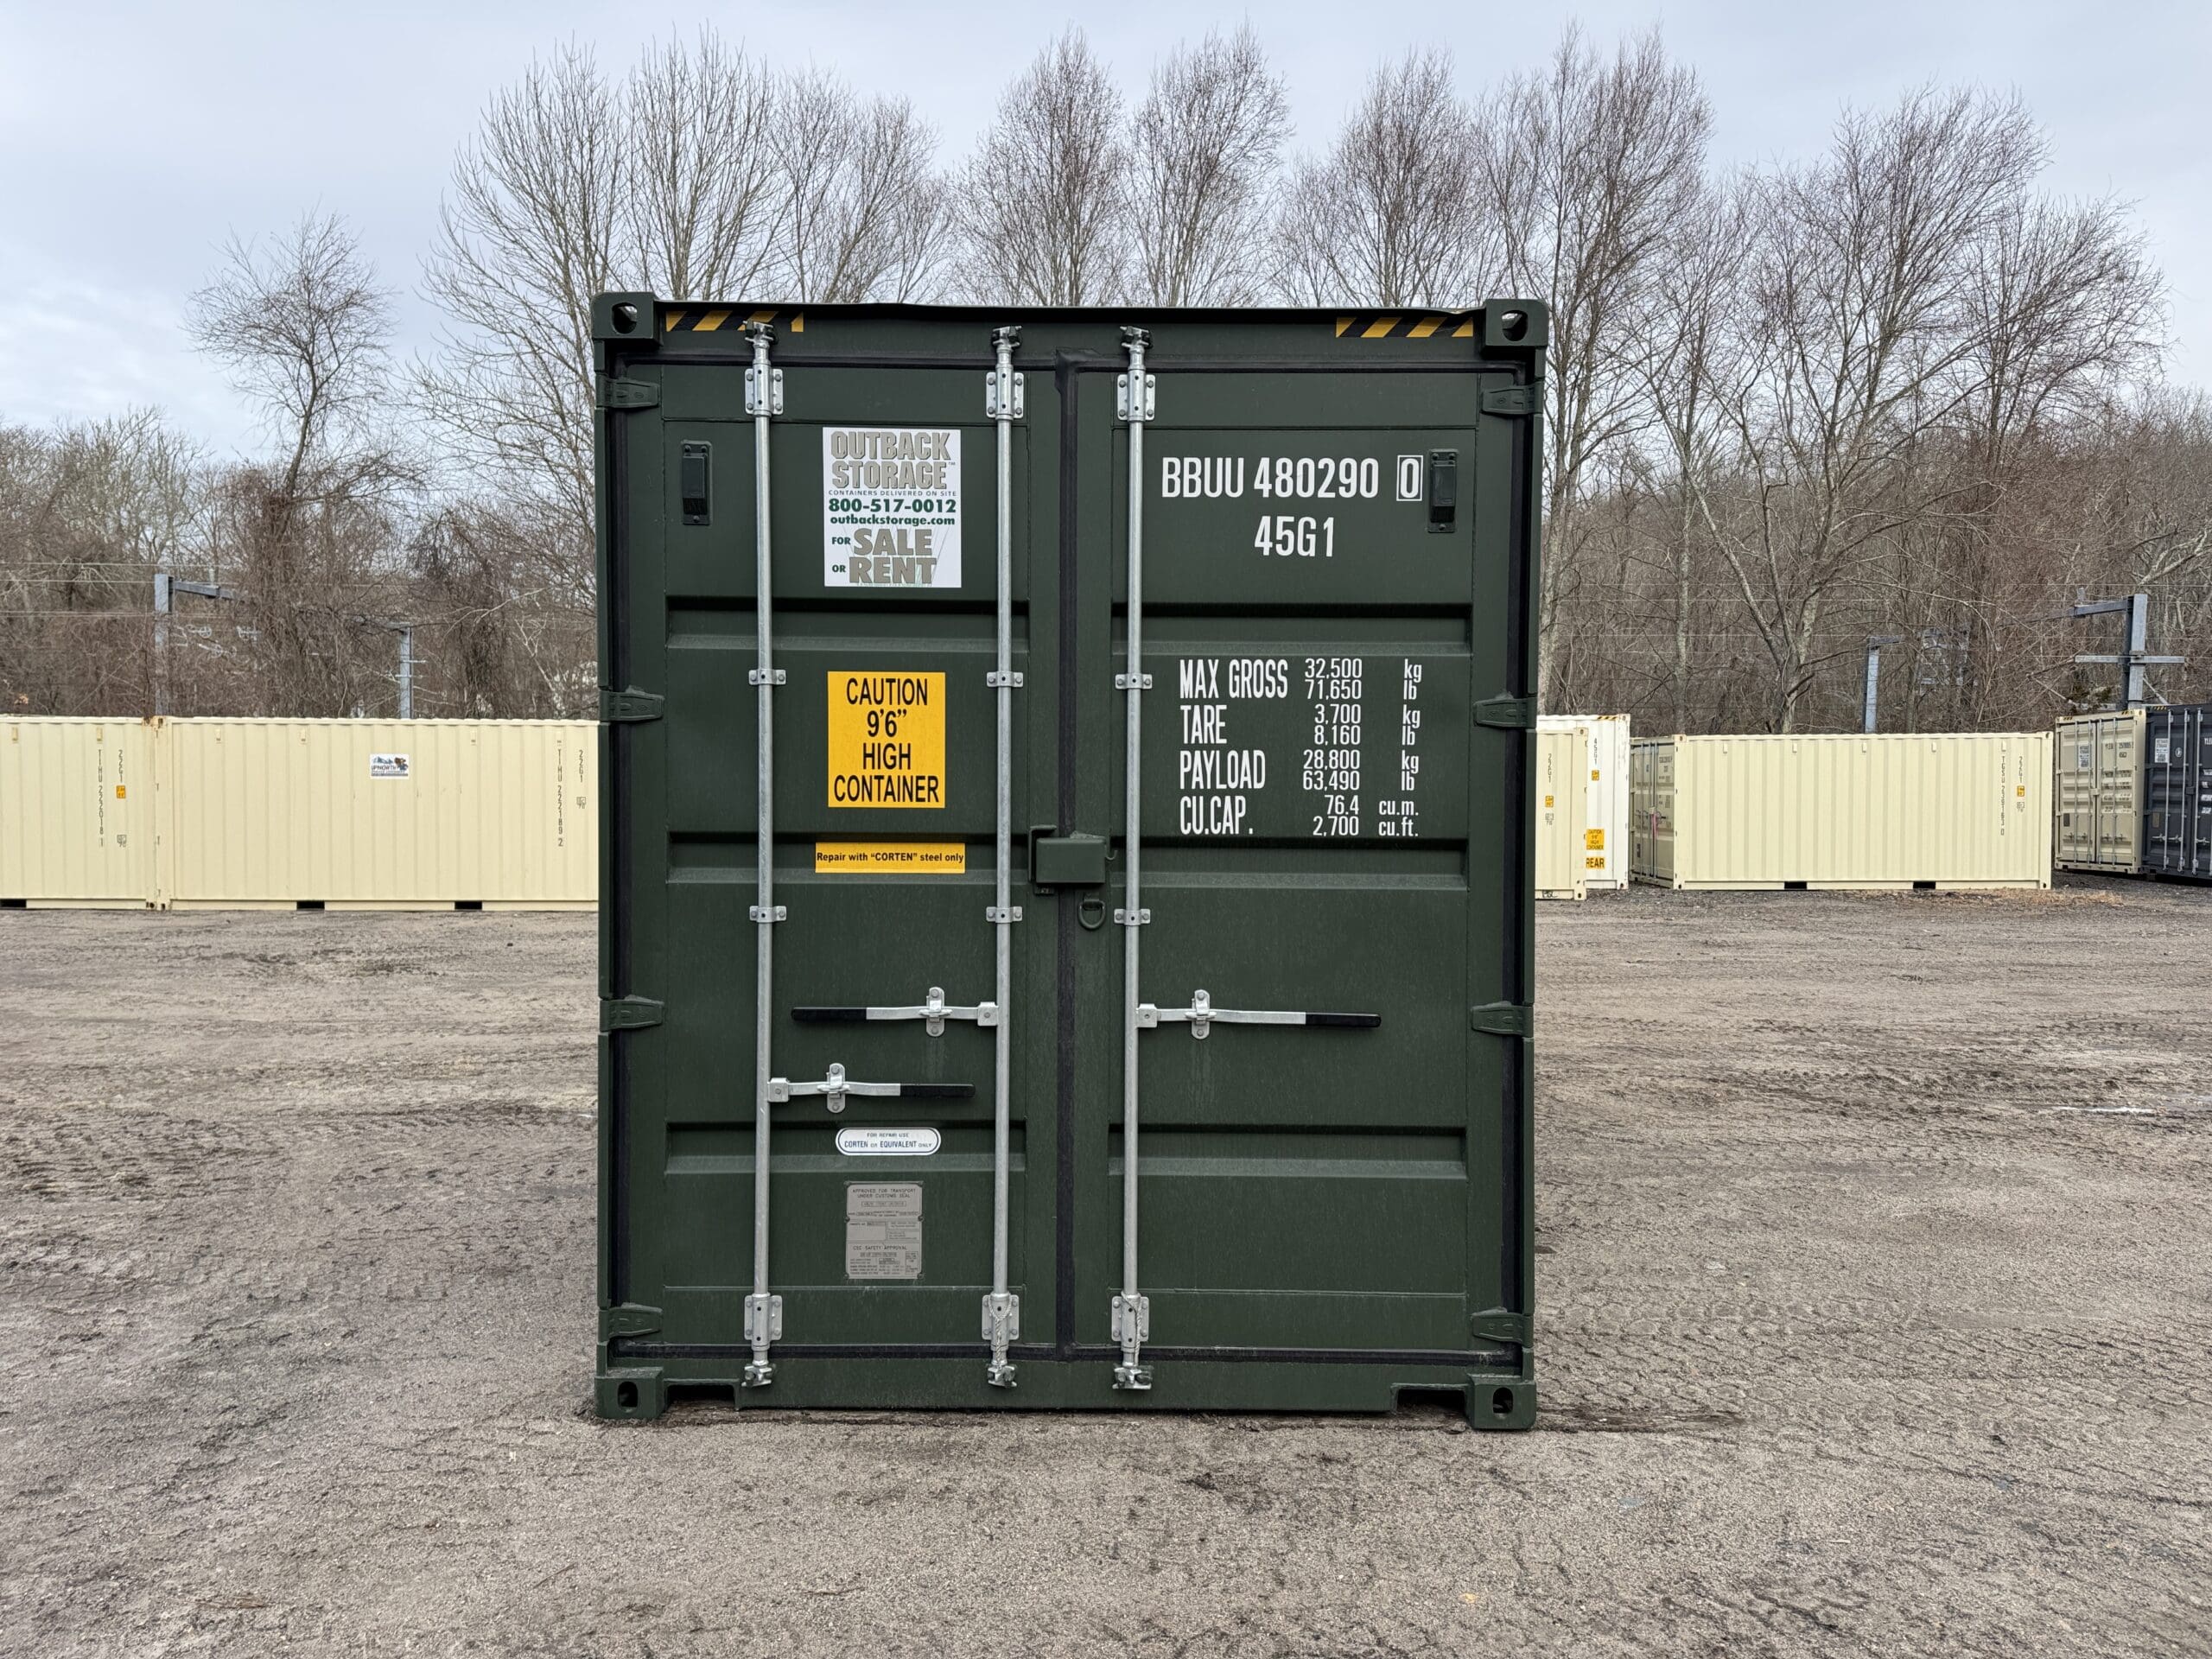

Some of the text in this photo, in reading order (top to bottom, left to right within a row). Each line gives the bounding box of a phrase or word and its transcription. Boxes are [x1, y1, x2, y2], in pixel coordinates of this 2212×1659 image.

[831, 431, 951, 460] OUTBACK
[832, 461, 947, 489] STORAGE
[1162, 457, 1420, 499] BBUU 480290 0
[829, 499, 956, 513] 800-517-0012
[830, 514, 955, 526] outbackstorage.com
[853, 528, 932, 555] SALE
[1255, 515, 1334, 557] 45G1
[849, 557, 937, 584] RENT
[1180, 659, 1288, 699] MAX GROSS
[1305, 658, 1422, 683] 32,500 kg
[847, 678, 928, 705] CAUTION
[1305, 679, 1417, 700] 71,650 lb
[1180, 705, 1227, 744] TARE
[1315, 704, 1421, 728] 3,700 kg
[1314, 725, 1415, 746] 8,160 lb
[864, 743, 911, 770] HIGH
[1180, 750, 1265, 790] PAYLOAD
[1303, 750, 1419, 774] 28,800 kg
[834, 775, 939, 802] CONTAINER
[1303, 770, 1415, 791] 63,490 lb
[1324, 795, 1419, 816] 76.4 cu.m.
[1313, 816, 1418, 836] 2,700 cu.ft.
[817, 852, 845, 862] Repair
[849, 852, 868, 861] with
[920, 852, 942, 861] steel
[945, 853, 964, 863] only
